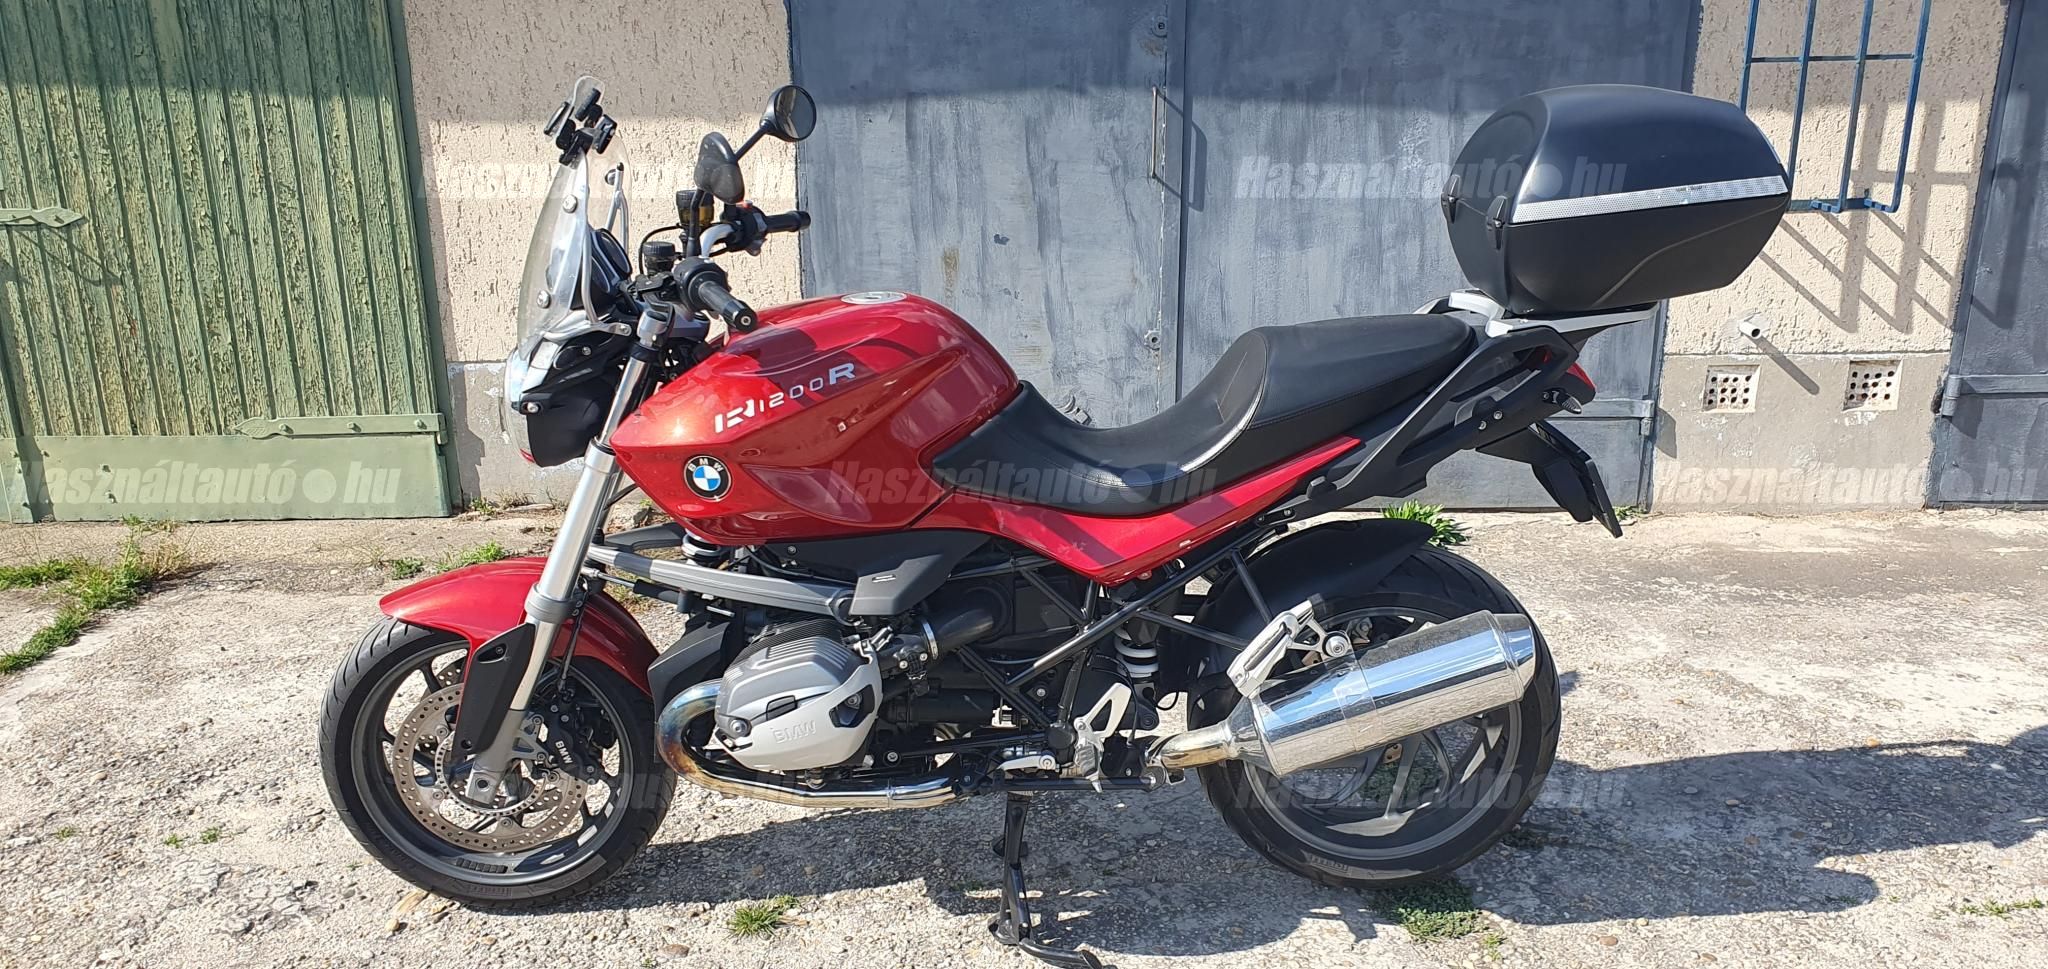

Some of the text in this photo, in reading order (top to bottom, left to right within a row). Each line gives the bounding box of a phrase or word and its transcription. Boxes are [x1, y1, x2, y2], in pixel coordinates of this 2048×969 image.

[687, 458, 724, 472] BMW
[773, 720, 817, 744] BMW
[555, 740, 574, 764] BMW
